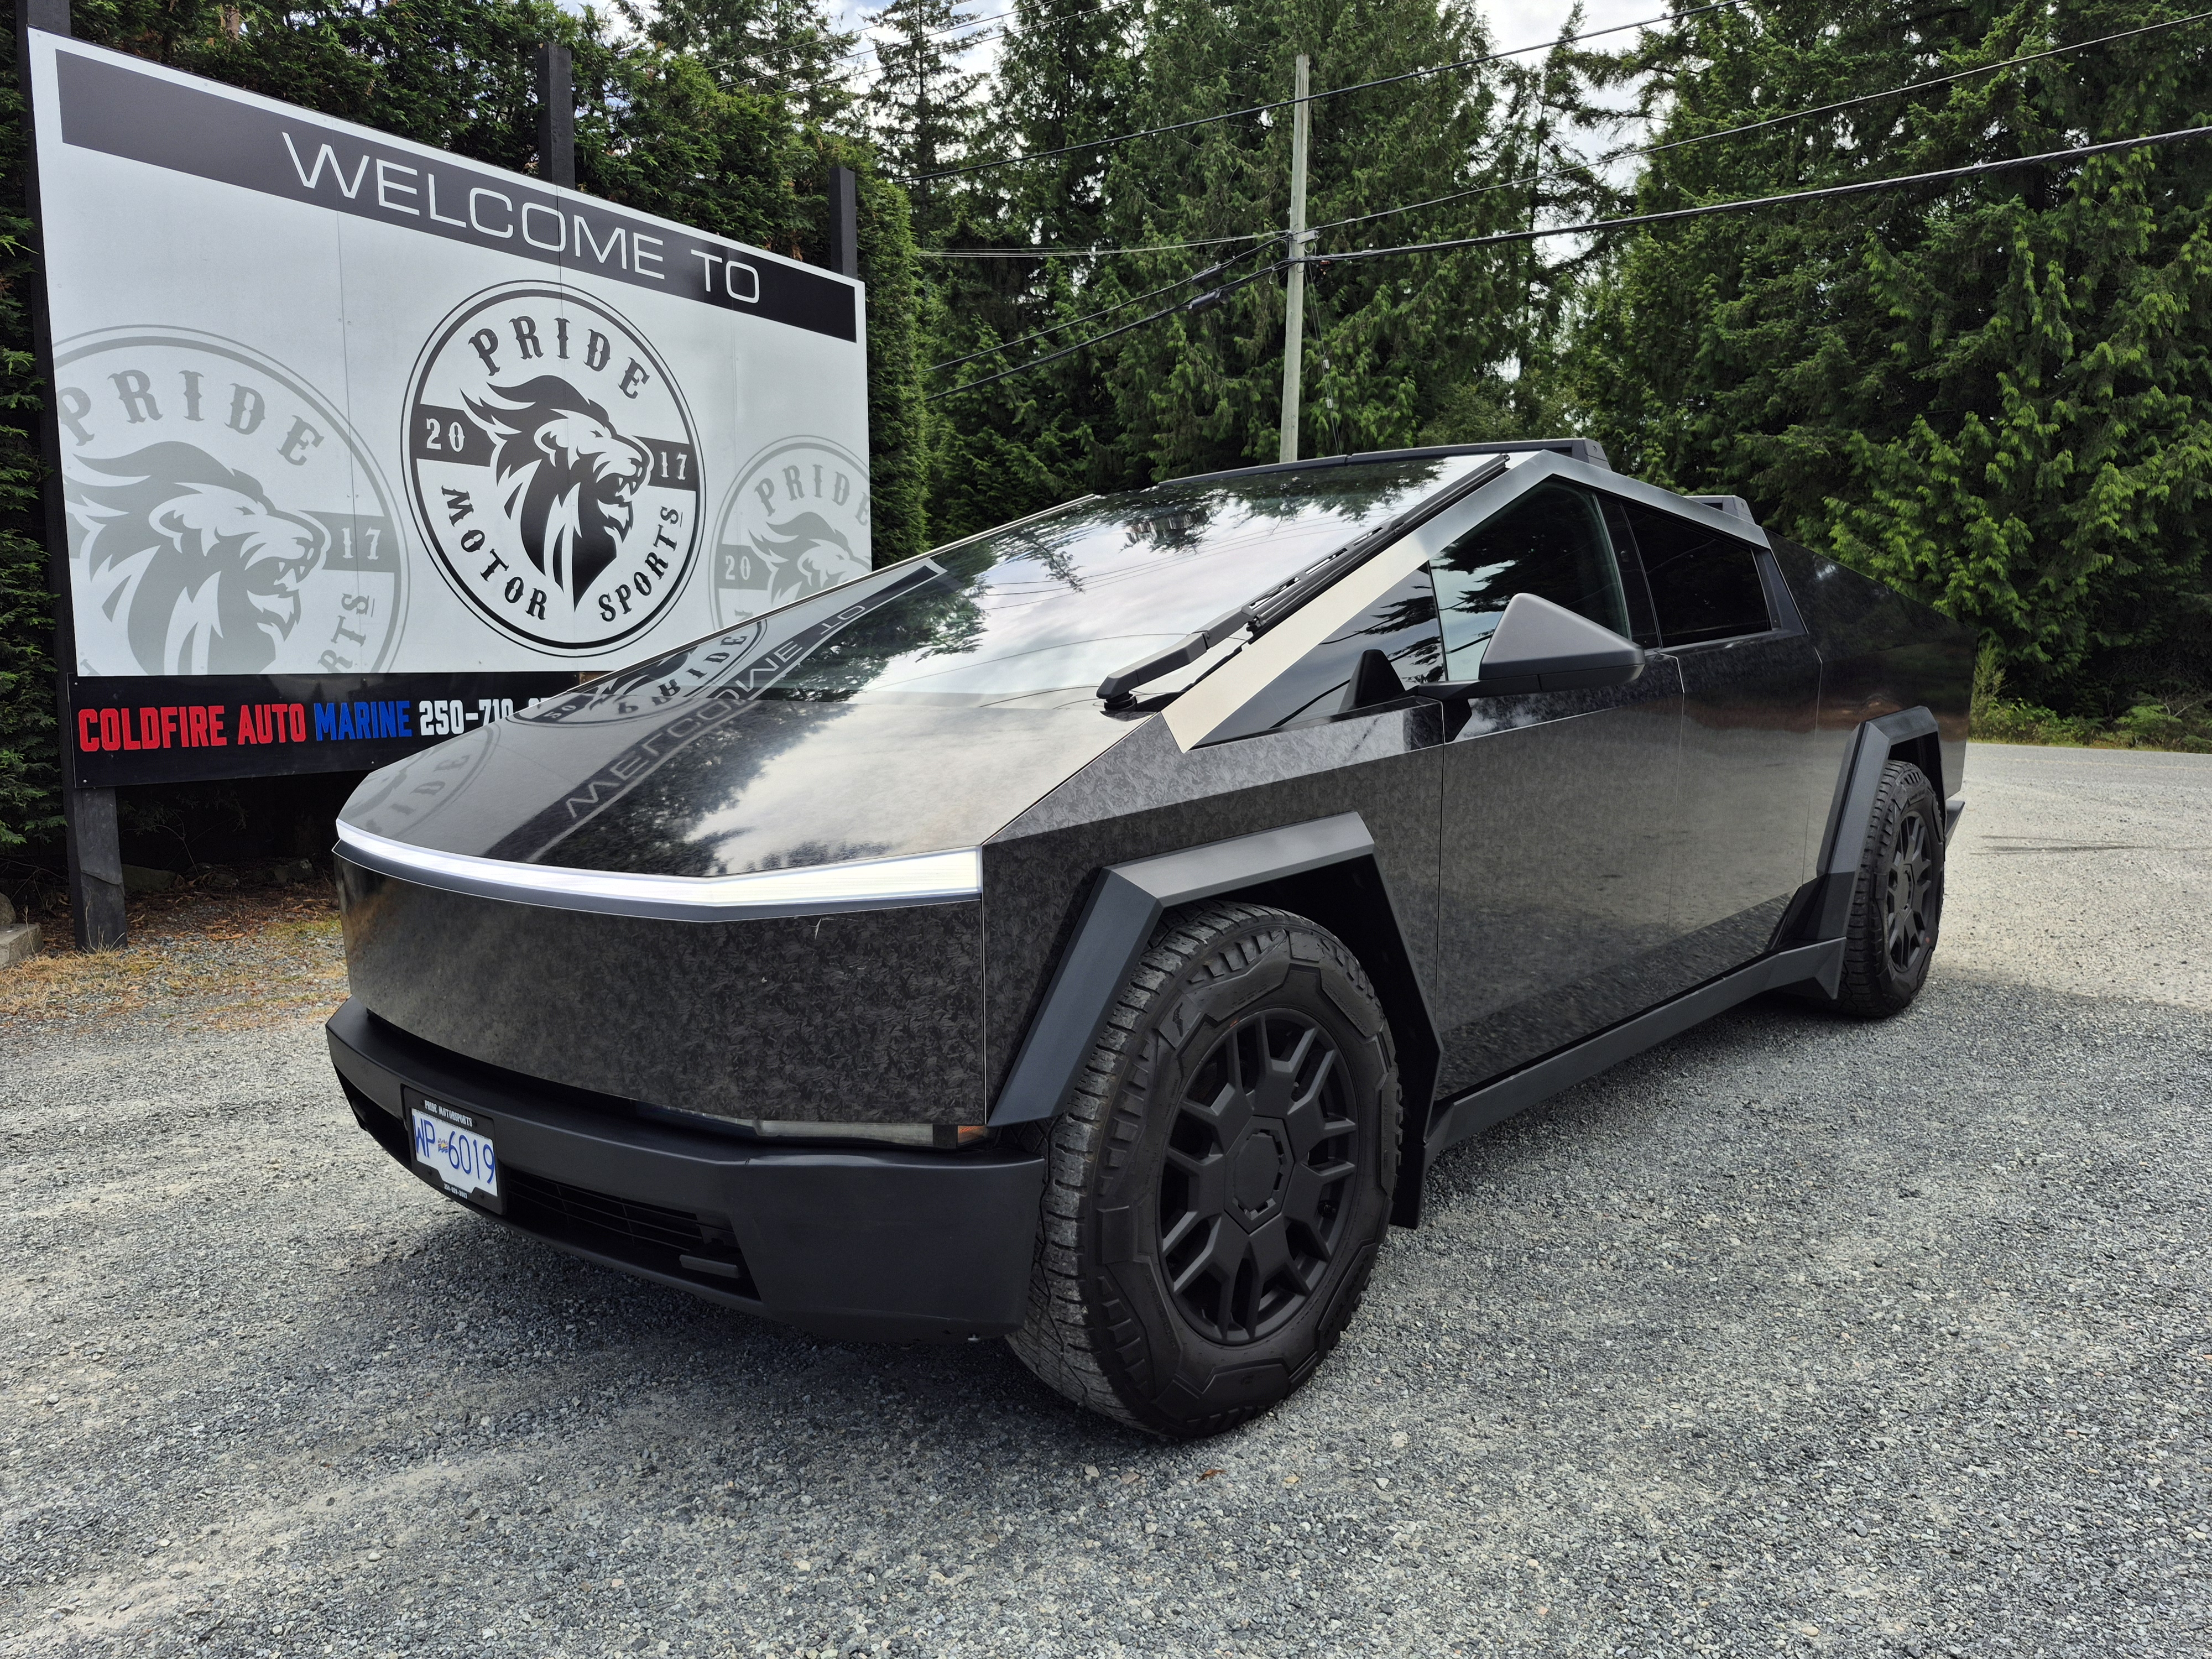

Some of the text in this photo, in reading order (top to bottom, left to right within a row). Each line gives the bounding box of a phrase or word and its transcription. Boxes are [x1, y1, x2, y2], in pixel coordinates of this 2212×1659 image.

[281, 132, 760, 304] WELCOME TO
[468, 315, 650, 400] PRIDE
[57, 369, 325, 466] PRIDE
[425, 418, 465, 452] 20
[660, 450, 687, 481] 17
[341, 527, 380, 561] 17
[441, 484, 549, 621] MOTOR
[598, 505, 681, 623] SPORTS
[725, 555, 751, 581] 20
[78, 705, 227, 752] COLDFIRE
[237, 703, 306, 745] AUTO
[314, 700, 413, 742] MARINE
[413, 1115, 435, 1159] WP
[448, 1130, 495, 1184] 6019
